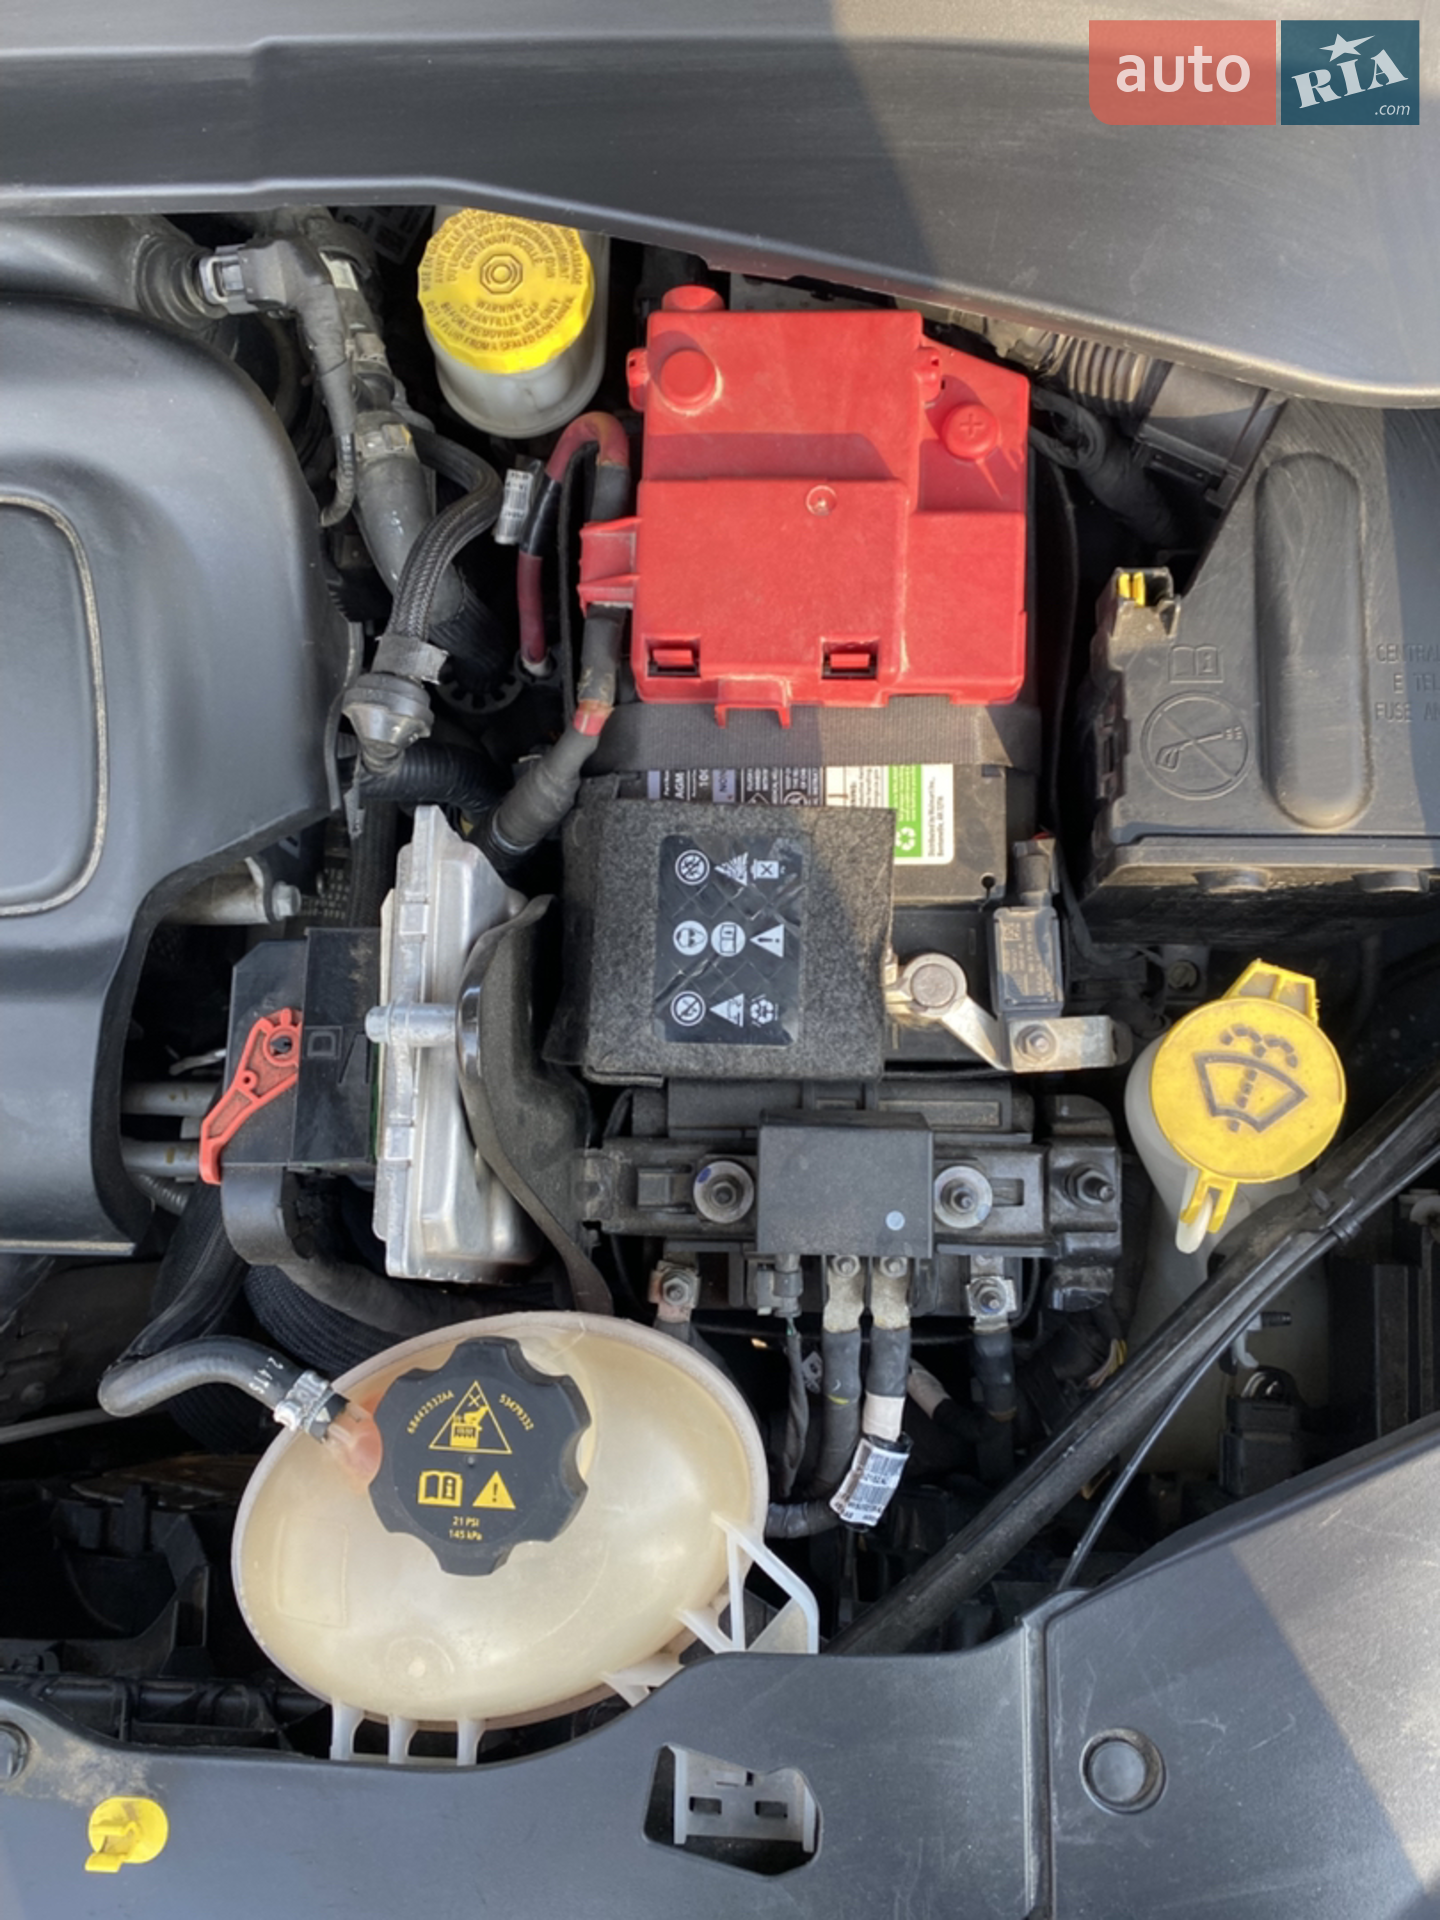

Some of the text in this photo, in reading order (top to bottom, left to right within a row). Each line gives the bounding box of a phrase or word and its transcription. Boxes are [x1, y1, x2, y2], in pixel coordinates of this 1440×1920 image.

[426, 301, 440, 317] DOT
[464, 338, 489, 351] FROM
[500, 335, 535, 351] SEALED
[441, 302, 467, 331] BEFORE
[522, 316, 541, 333] USE
[540, 298, 559, 320] ONLY
[461, 302, 540, 327] CLEAN FILLER CAP
[1374, 701, 1413, 723] FUSE
[674, 772, 685, 799] AGM
[452, 1515, 480, 1528] 21 PSI
[448, 1529, 483, 1541] 145 kPa
